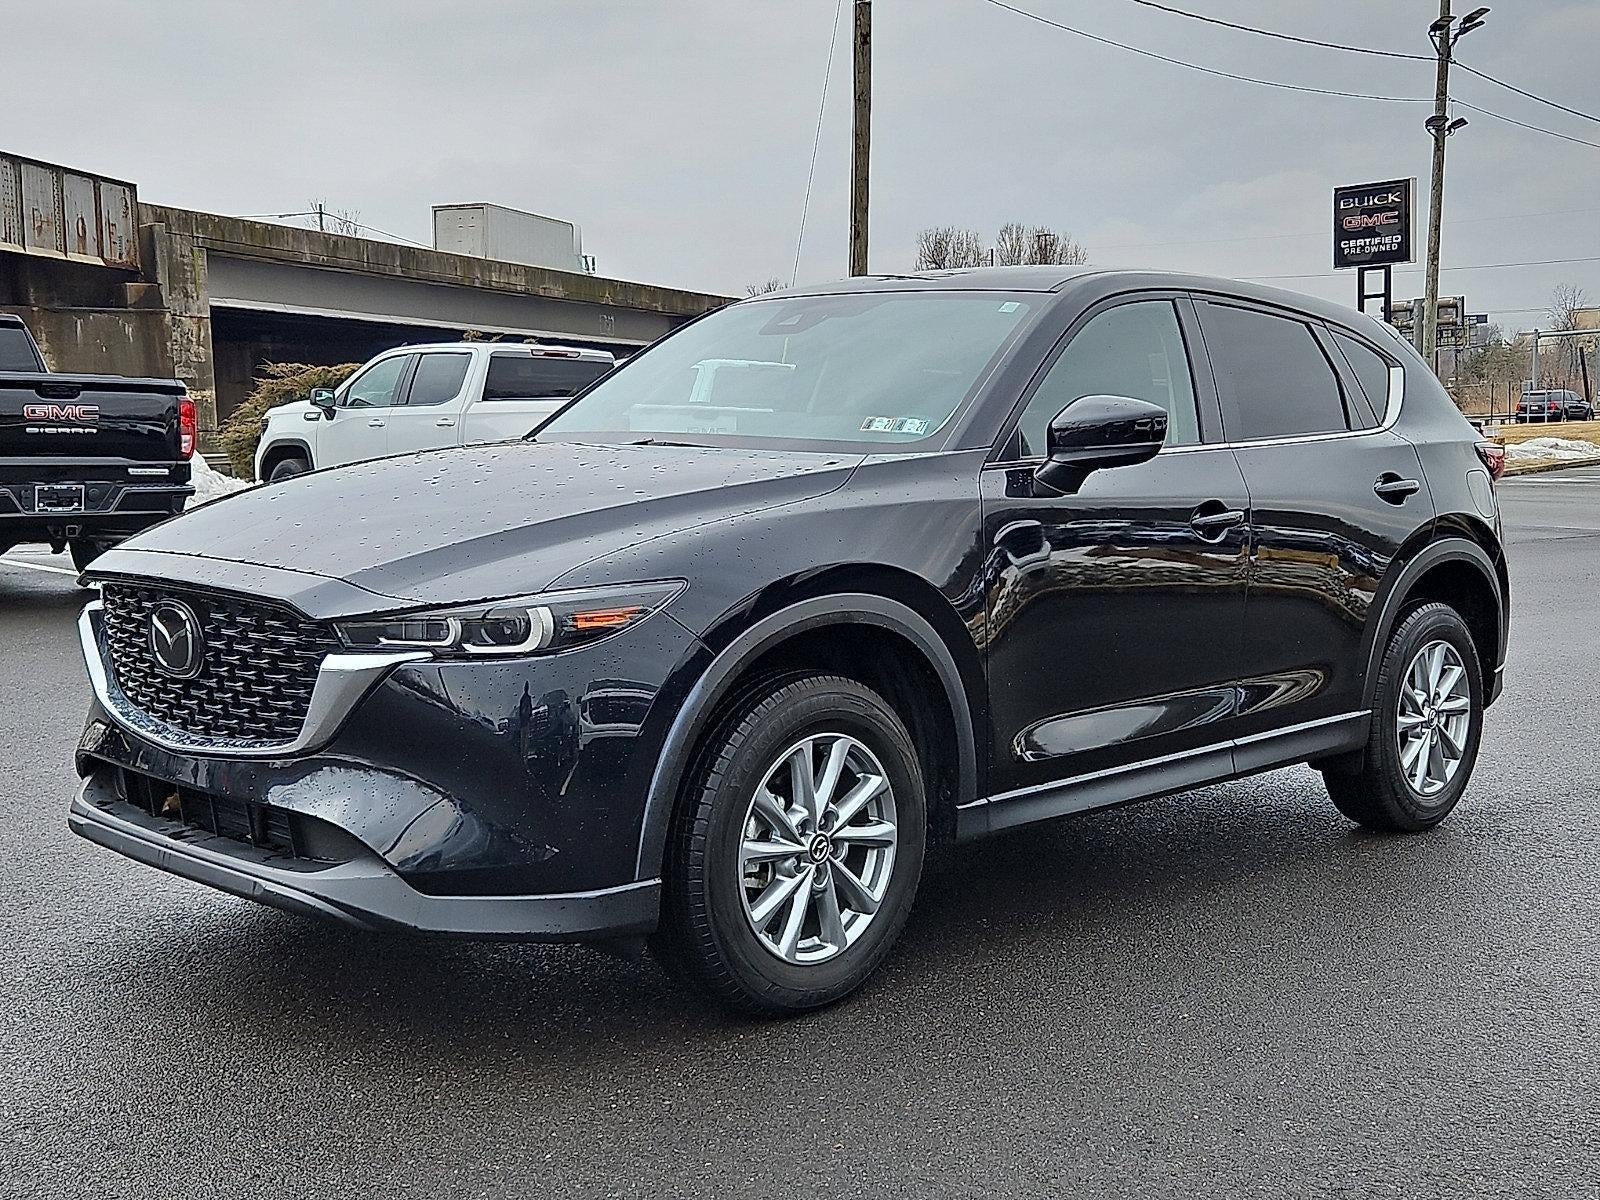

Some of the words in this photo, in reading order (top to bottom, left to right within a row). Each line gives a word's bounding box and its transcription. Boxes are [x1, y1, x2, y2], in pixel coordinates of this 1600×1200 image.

[1340, 191, 1402, 209] BUICK
[1343, 211, 1399, 230] GMC
[1340, 235, 1402, 248] CERTIFIED
[1344, 243, 1398, 255] PRE-OWNED
[23, 404, 99, 421] GMC
